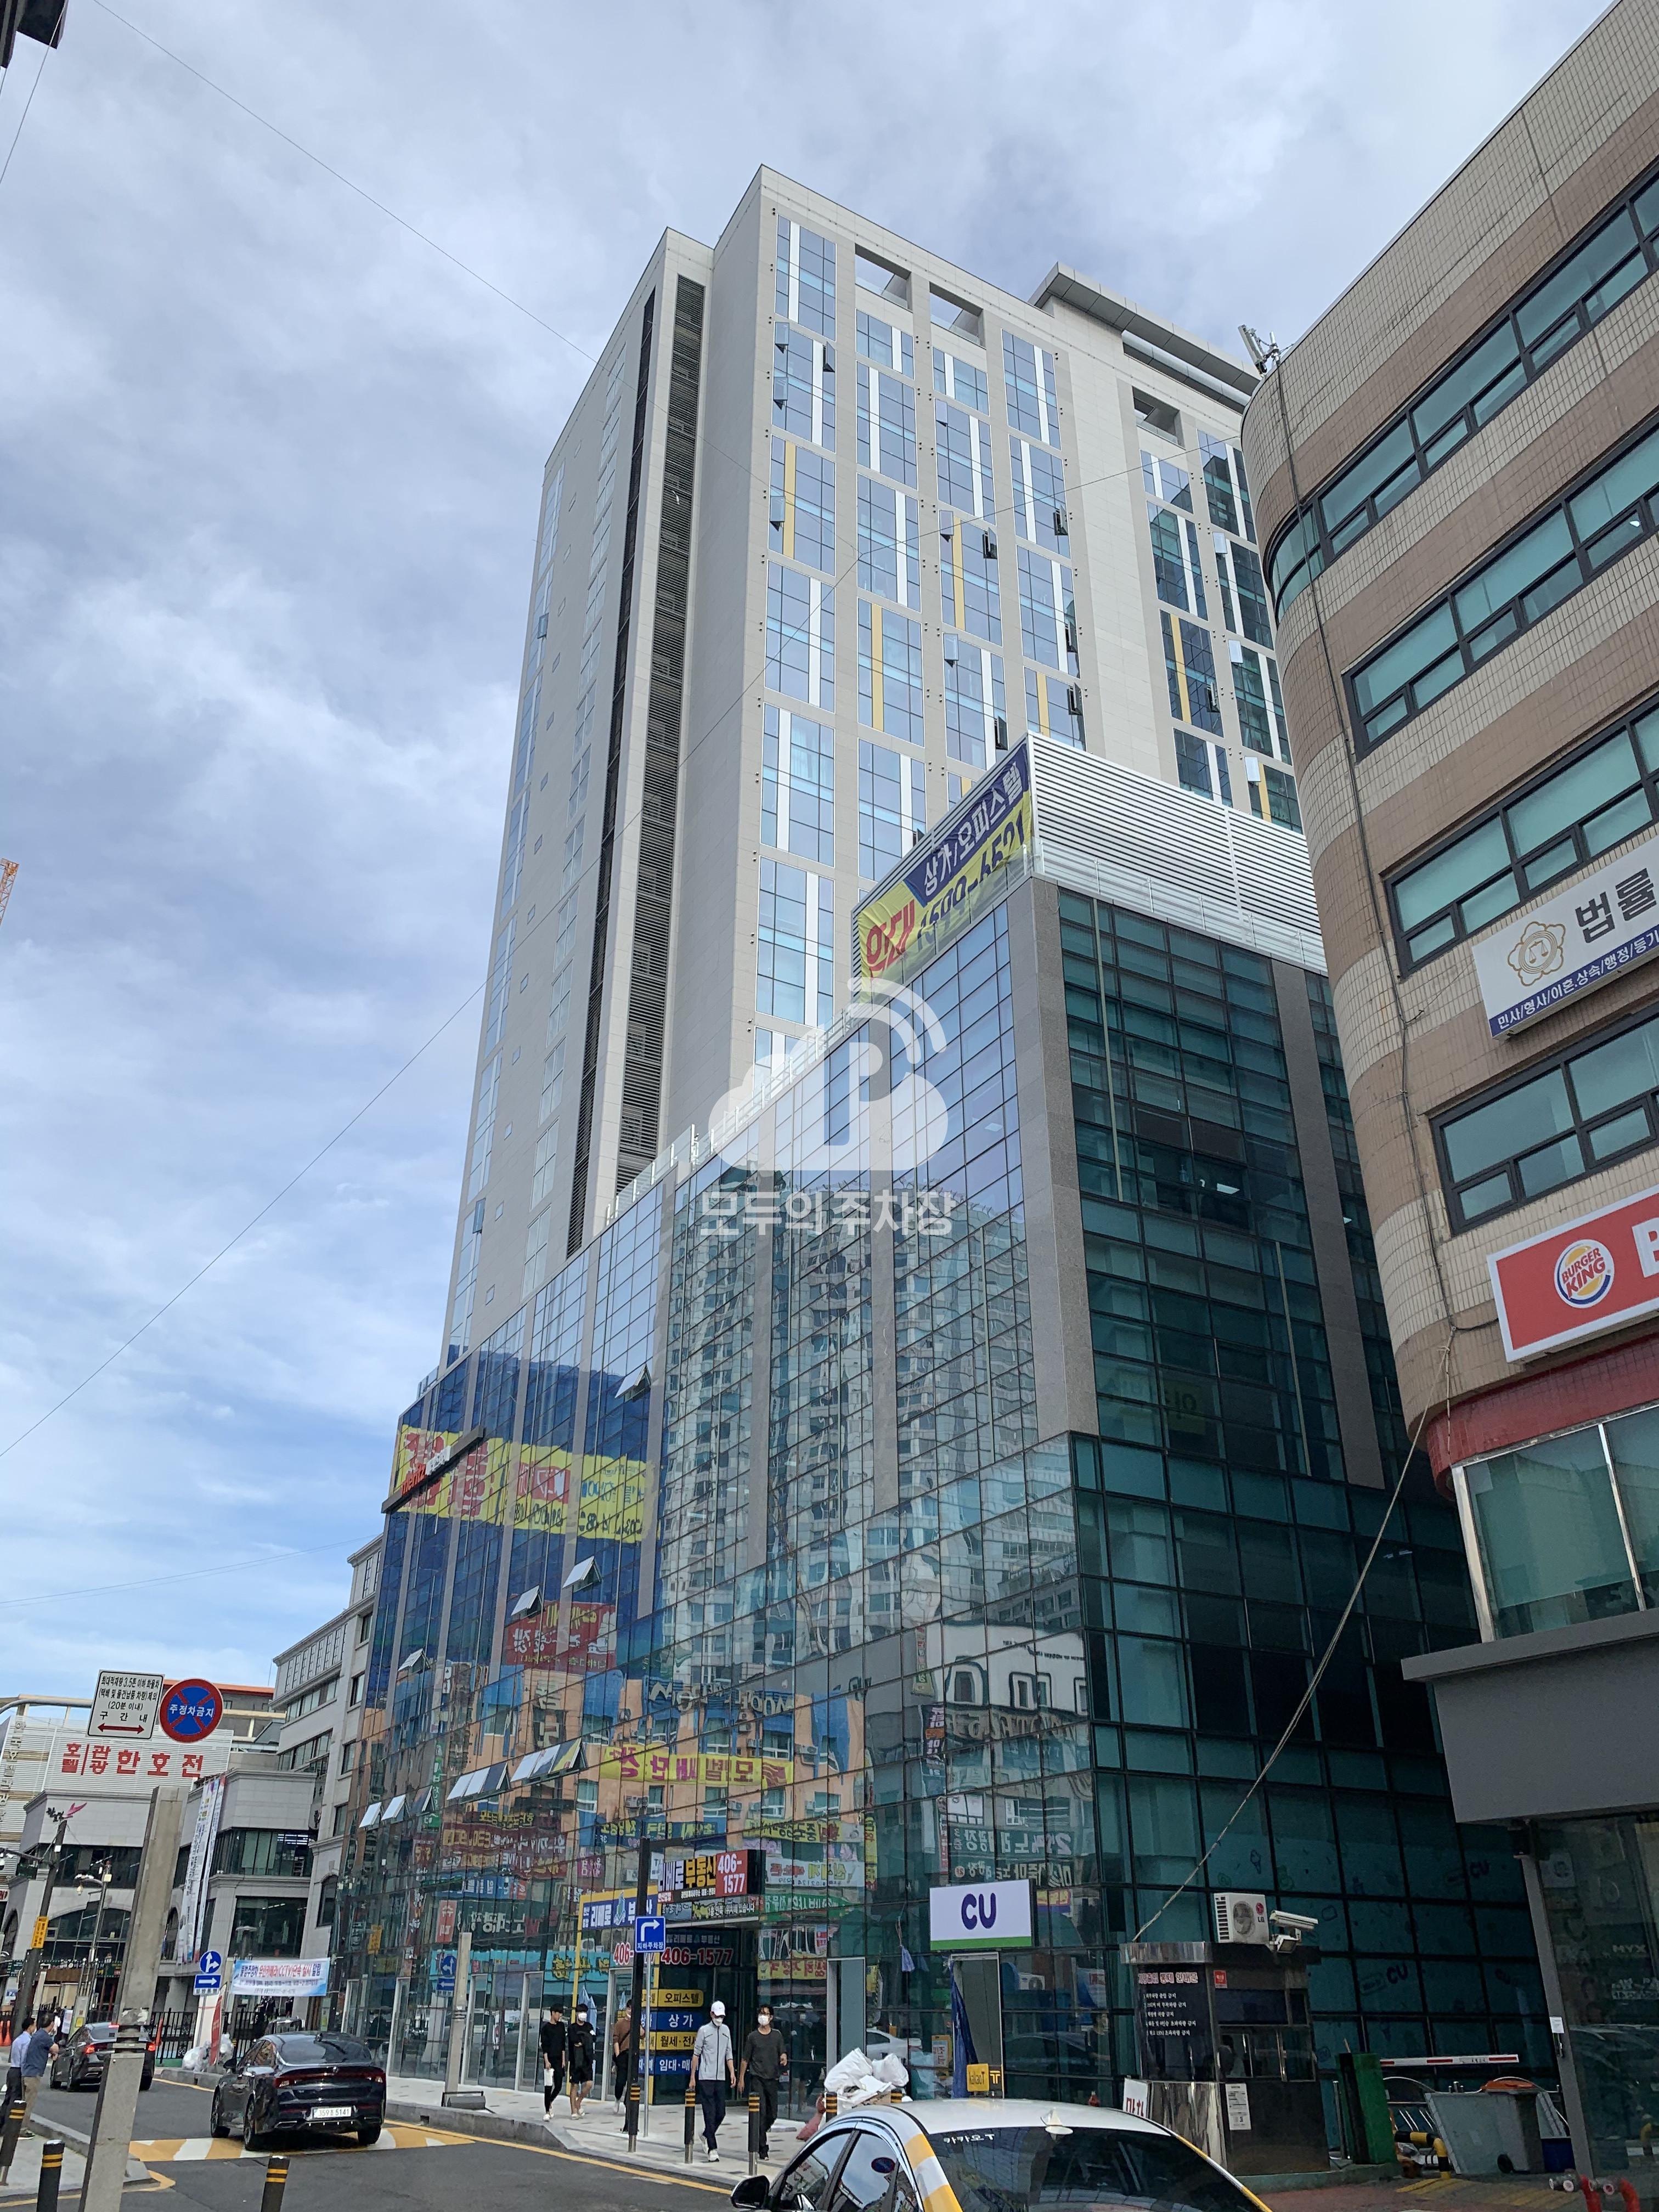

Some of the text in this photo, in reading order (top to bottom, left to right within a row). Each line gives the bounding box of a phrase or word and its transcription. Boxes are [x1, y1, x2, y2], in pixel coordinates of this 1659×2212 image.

[924, 761, 1023, 896] 상가/오피스텔
[1575, 868, 1657, 944] 법률
[1561, 1248, 1601, 1284] BURGER
[1565, 1257, 1606, 1300] KING
[101, 1675, 160, 1689] 최대적재량 3.5톤 이하 화물차
[111, 1689, 116, 1699] 및
[108, 1701, 143, 1711] (20분 이내)
[169, 1703, 215, 1718] 주정차금지
[718, 1853, 742, 1874] 406-
[724, 1873, 745, 1894] 1577
[590, 1904, 612, 1927] 리베로
[960, 1893, 997, 1931] CU
[637, 1942, 664, 1950] 지하주차장
[661, 1946, 733, 1966] 406-1577
[1176, 1972, 1198, 1984] 안내문
[664, 1993, 699, 2004] 오피스텔
